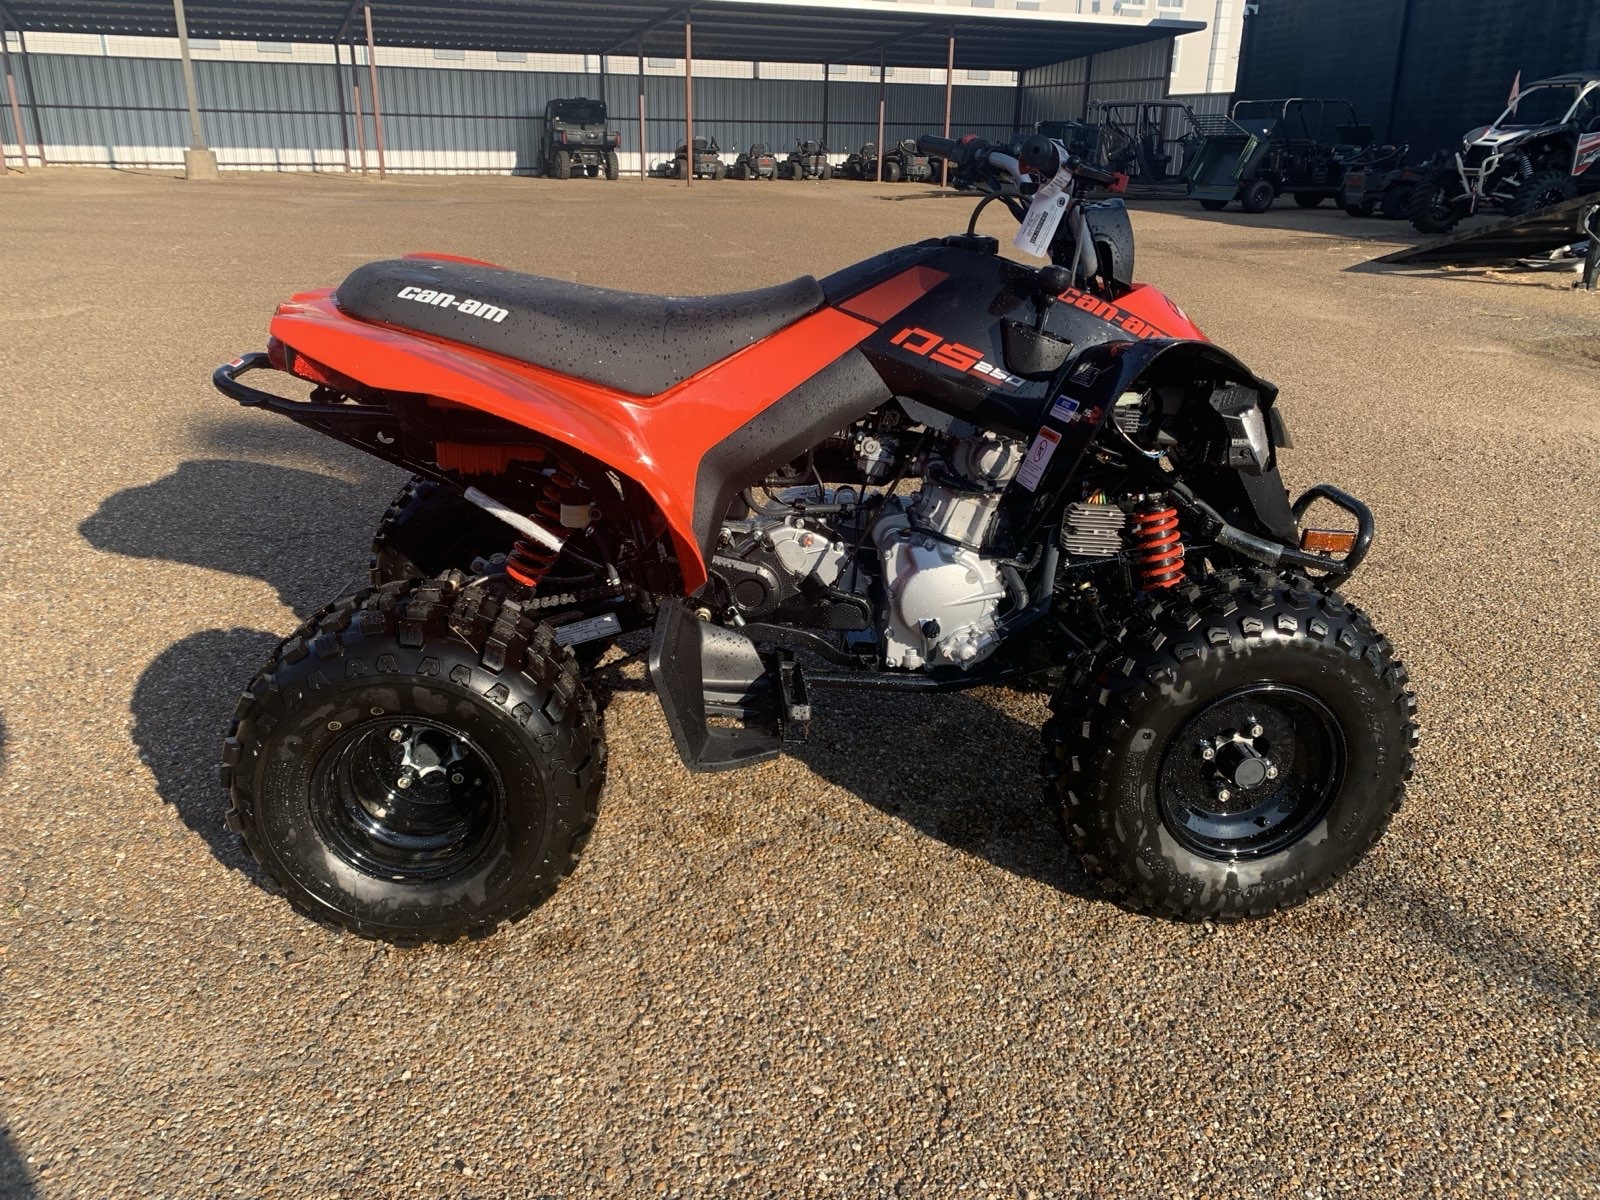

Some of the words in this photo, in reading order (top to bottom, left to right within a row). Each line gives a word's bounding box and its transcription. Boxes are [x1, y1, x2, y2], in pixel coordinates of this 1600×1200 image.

[397, 286, 509, 323] can-am
[890, 327, 985, 372] DS
[973, 360, 1027, 387] 250
